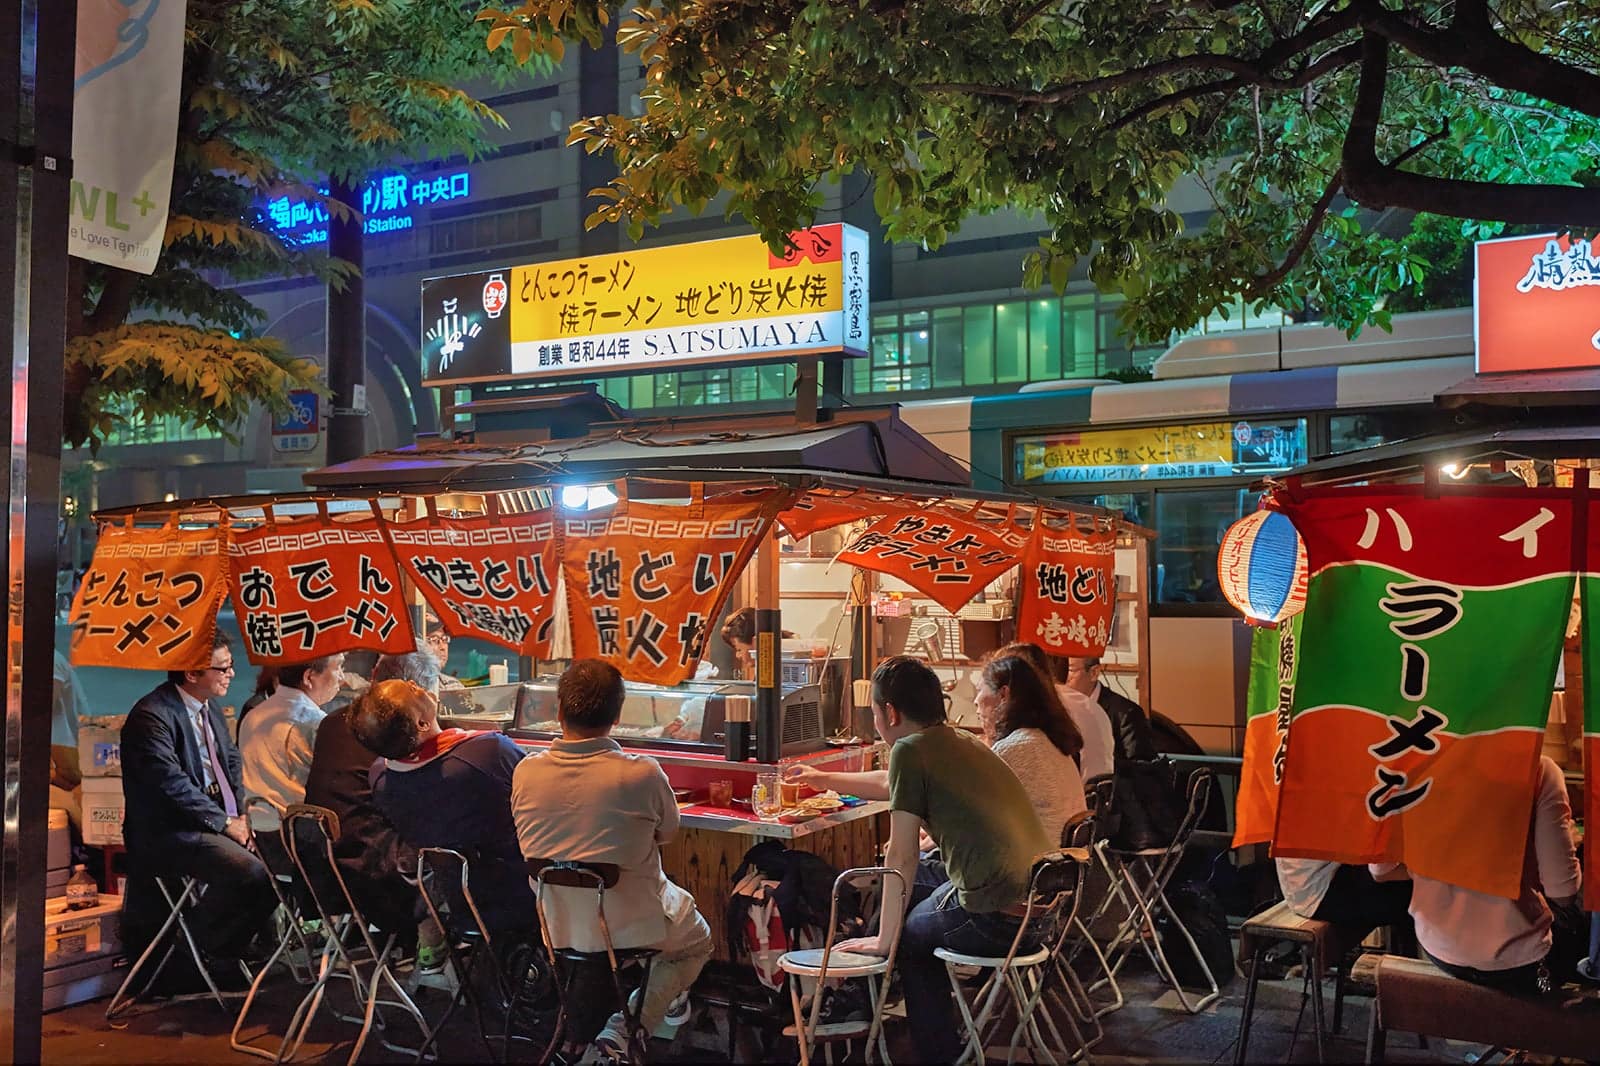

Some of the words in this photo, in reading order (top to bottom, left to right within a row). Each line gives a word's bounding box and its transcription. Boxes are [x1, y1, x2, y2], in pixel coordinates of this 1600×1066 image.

[412, 173, 469, 205] 中央口
[80, 226, 110, 247] Love
[368, 214, 412, 234] Station
[519, 258, 635, 303] とんこつラーメン
[558, 295, 663, 334] 焼ラーメン
[674, 272, 828, 319] 地どり炭火焼
[537, 343, 563, 367] 創業
[568, 337, 631, 363] 昭和44年
[643, 318, 829, 357] SATSUMAYA
[239, 553, 394, 610] おでん
[410, 552, 552, 601] やきとり
[586, 547, 737, 603] 地どり
[244, 597, 399, 657] 焼ラーメン
[1365, 581, 1464, 822] ラーメン
